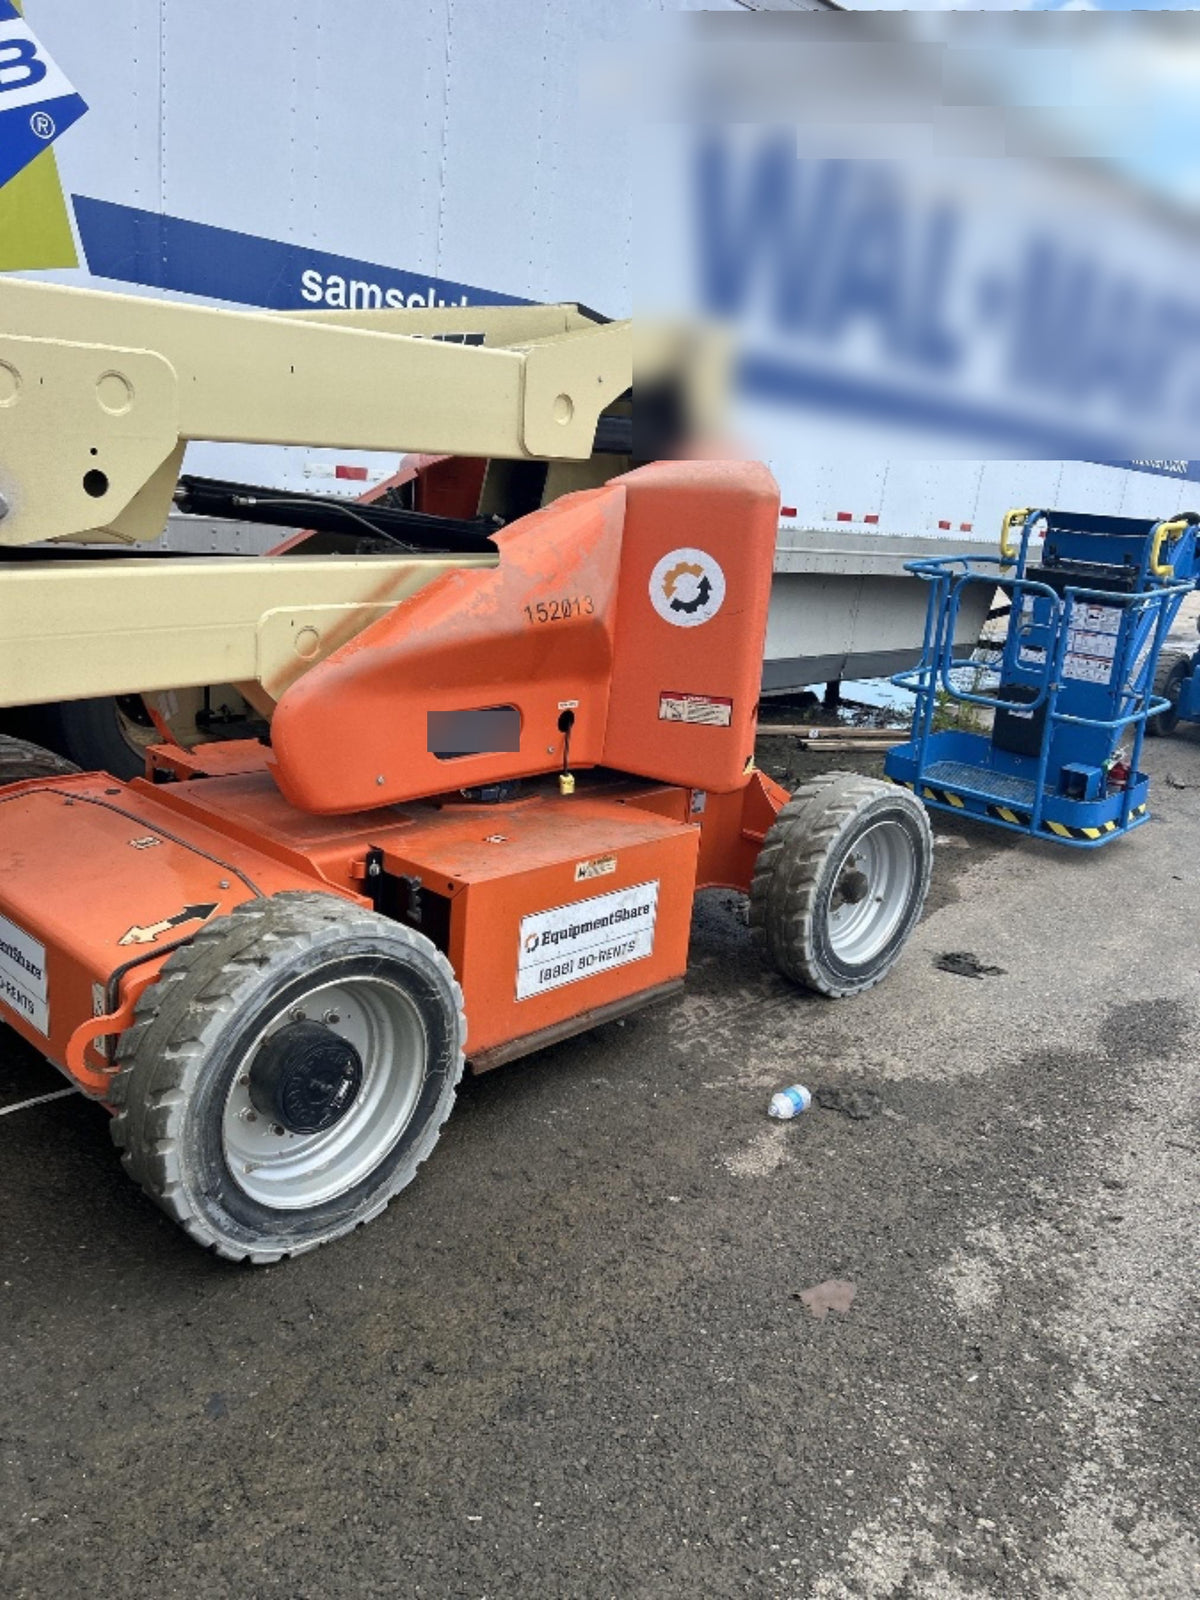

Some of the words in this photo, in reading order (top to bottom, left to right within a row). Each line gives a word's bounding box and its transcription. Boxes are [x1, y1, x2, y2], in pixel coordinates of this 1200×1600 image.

[301, 269, 468, 309] samsc
[524, 595, 594, 623] 152013
[541, 904, 650, 946] EquipmentShare
